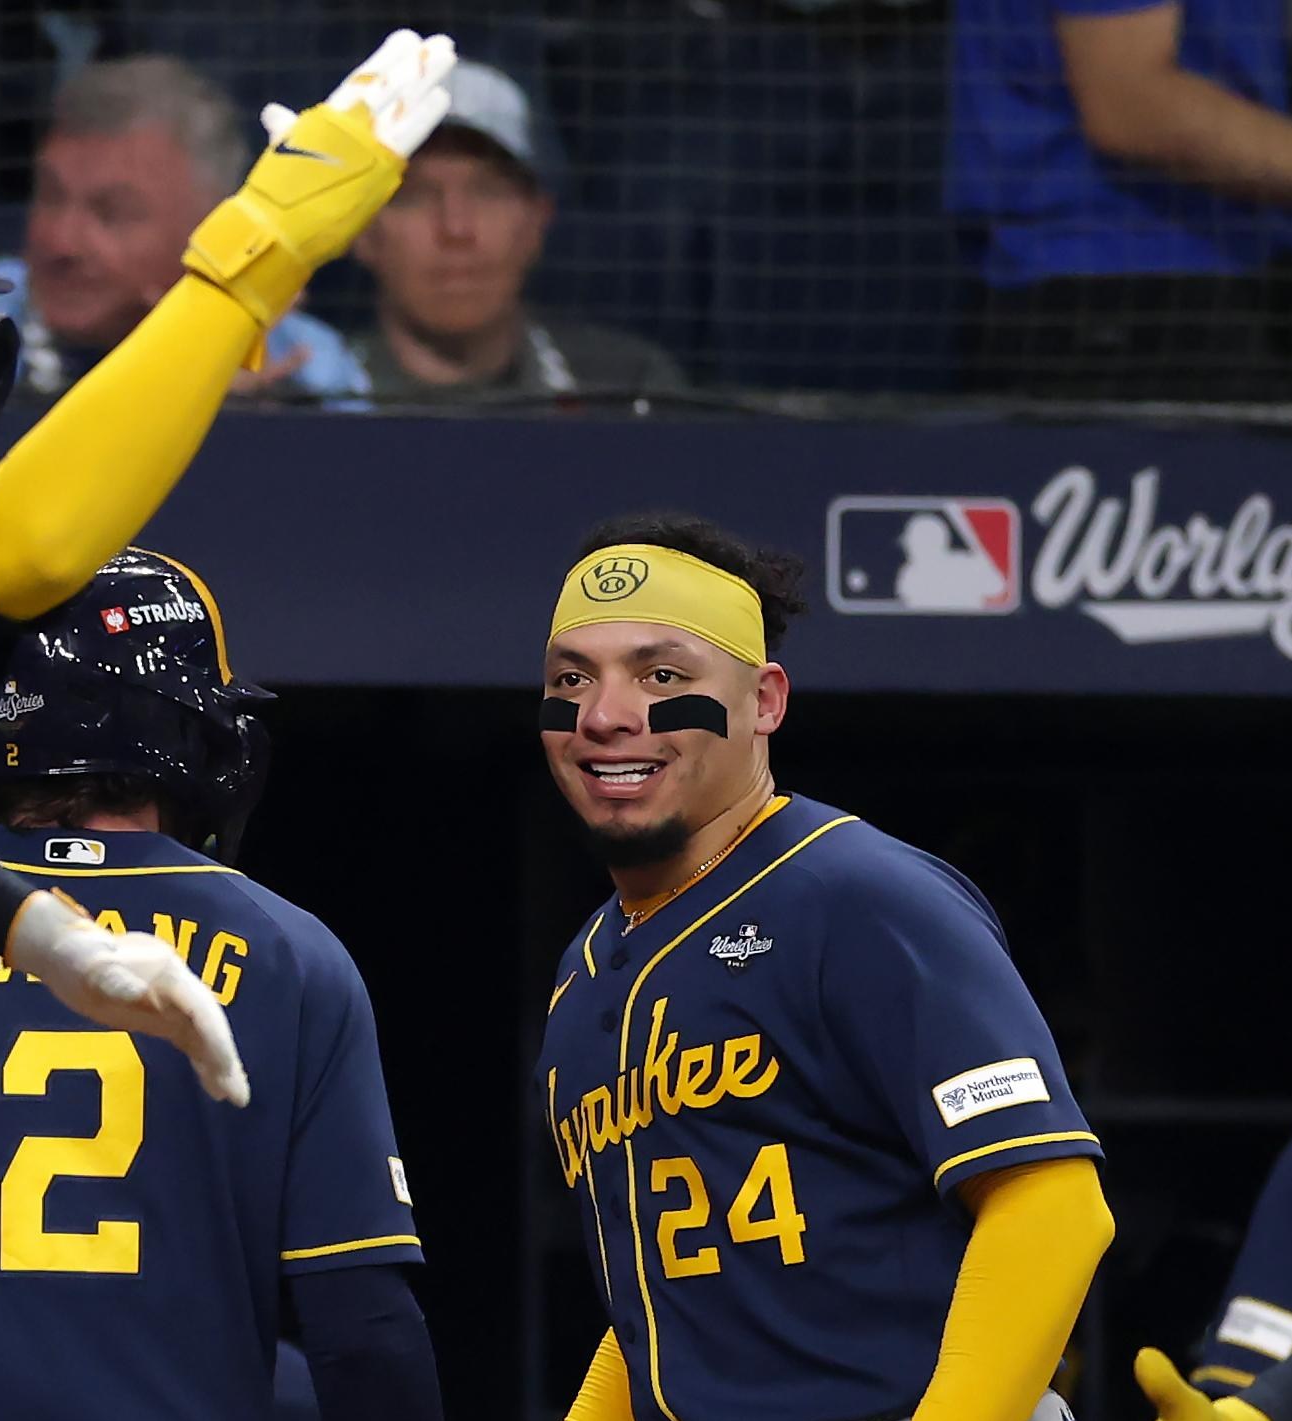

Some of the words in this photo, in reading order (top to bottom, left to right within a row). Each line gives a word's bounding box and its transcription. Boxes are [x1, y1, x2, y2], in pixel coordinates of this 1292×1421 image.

[127, 600, 206, 627] STRAUSS
[7, 743, 20, 767] 2
[966, 1071, 1040, 1094] Northwestern
[971, 1083, 1014, 1104] Mutual
[0, 1030, 145, 1274] 2
[650, 1143, 807, 1280] 24
